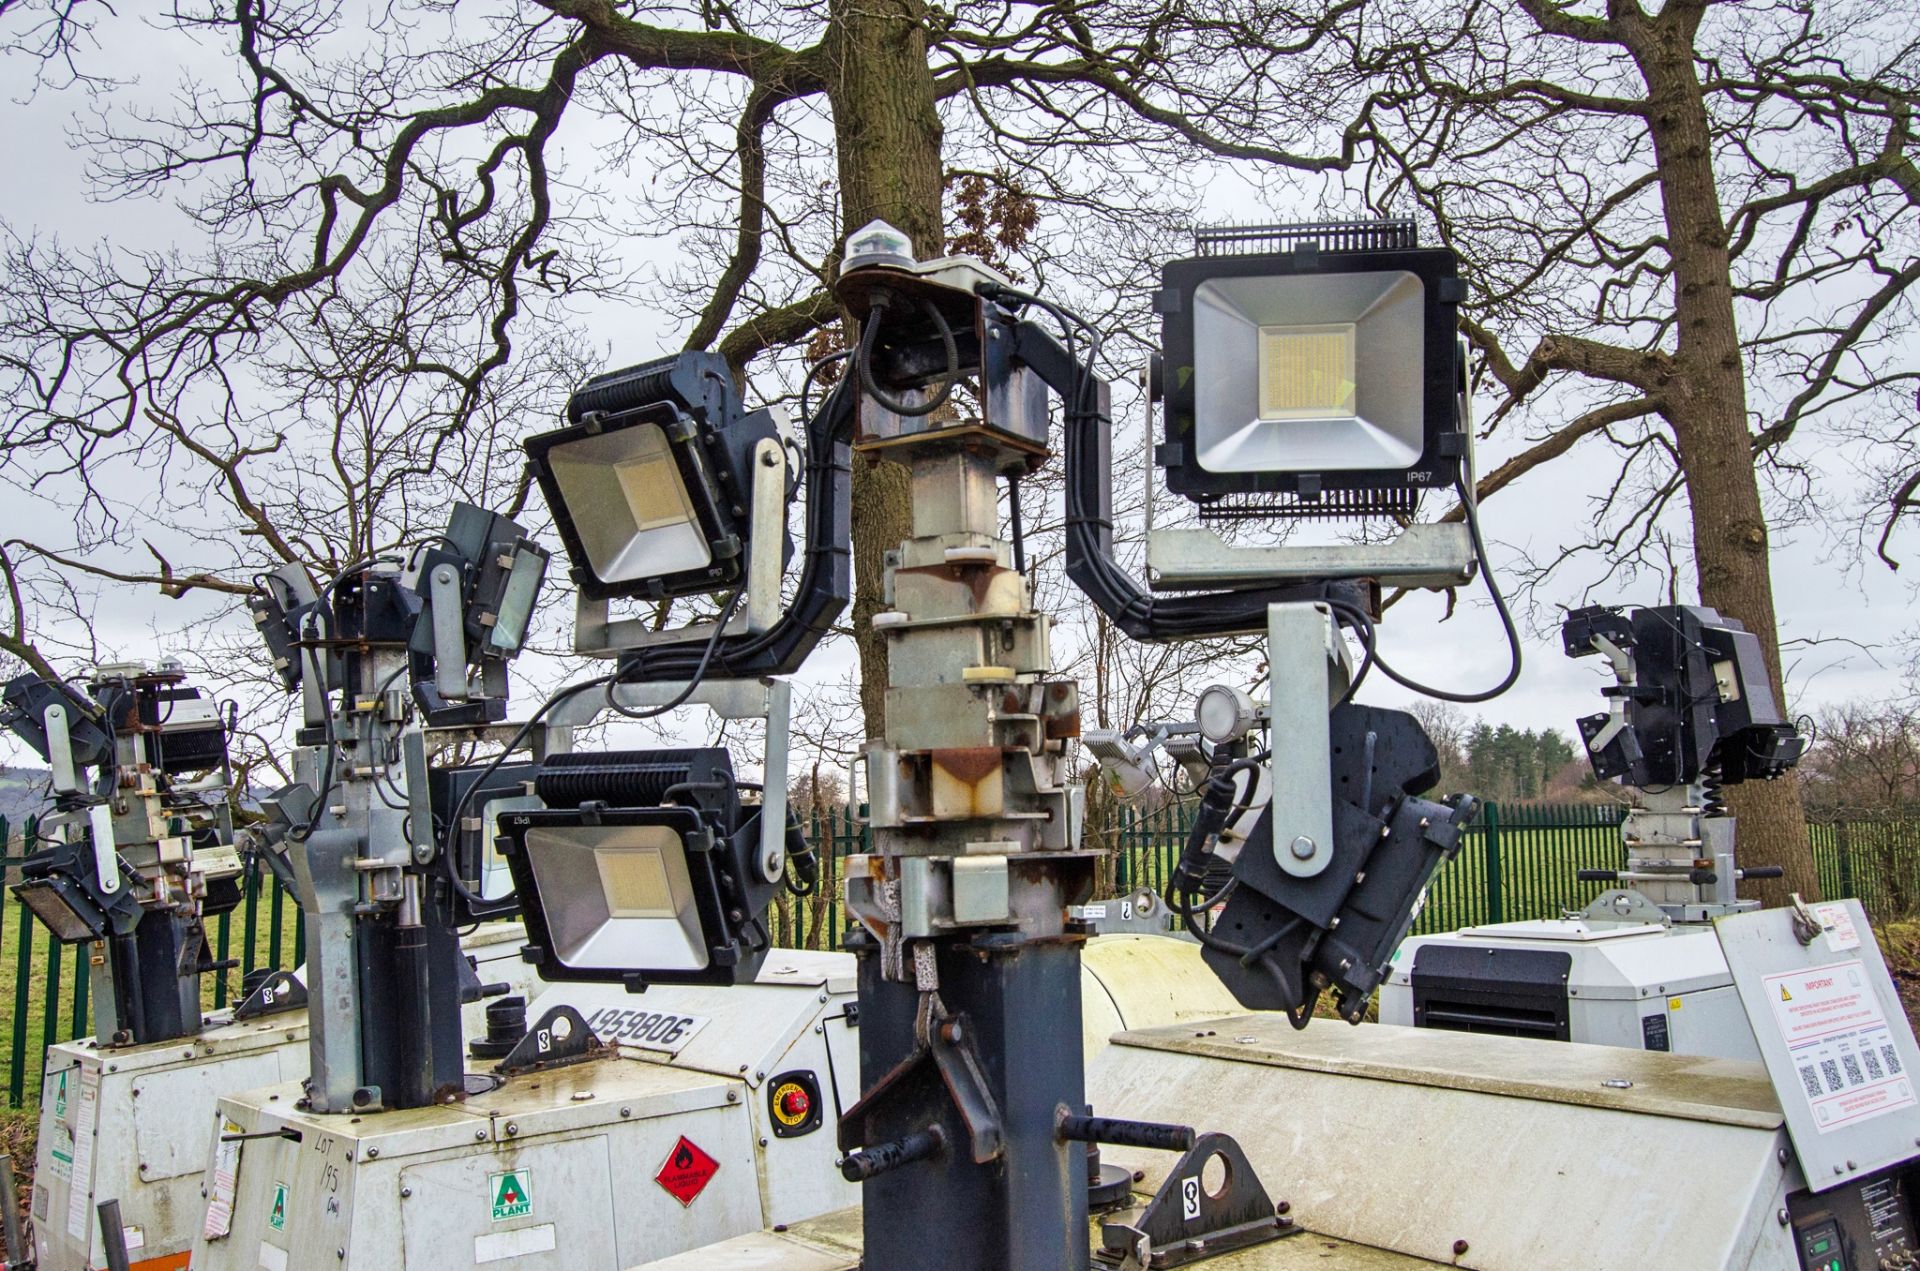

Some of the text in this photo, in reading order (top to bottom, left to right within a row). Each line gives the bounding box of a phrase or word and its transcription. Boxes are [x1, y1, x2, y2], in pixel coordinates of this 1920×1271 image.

[1407, 471, 1432, 482] IP67
[513, 816, 531, 825] IP67
[1804, 978, 1834, 991] IMPORTANT
[315, 1133, 334, 1157] LOT
[320, 1162, 338, 1193] 195
[495, 1175, 527, 1206] A
[493, 1204, 529, 1218] PLANT
